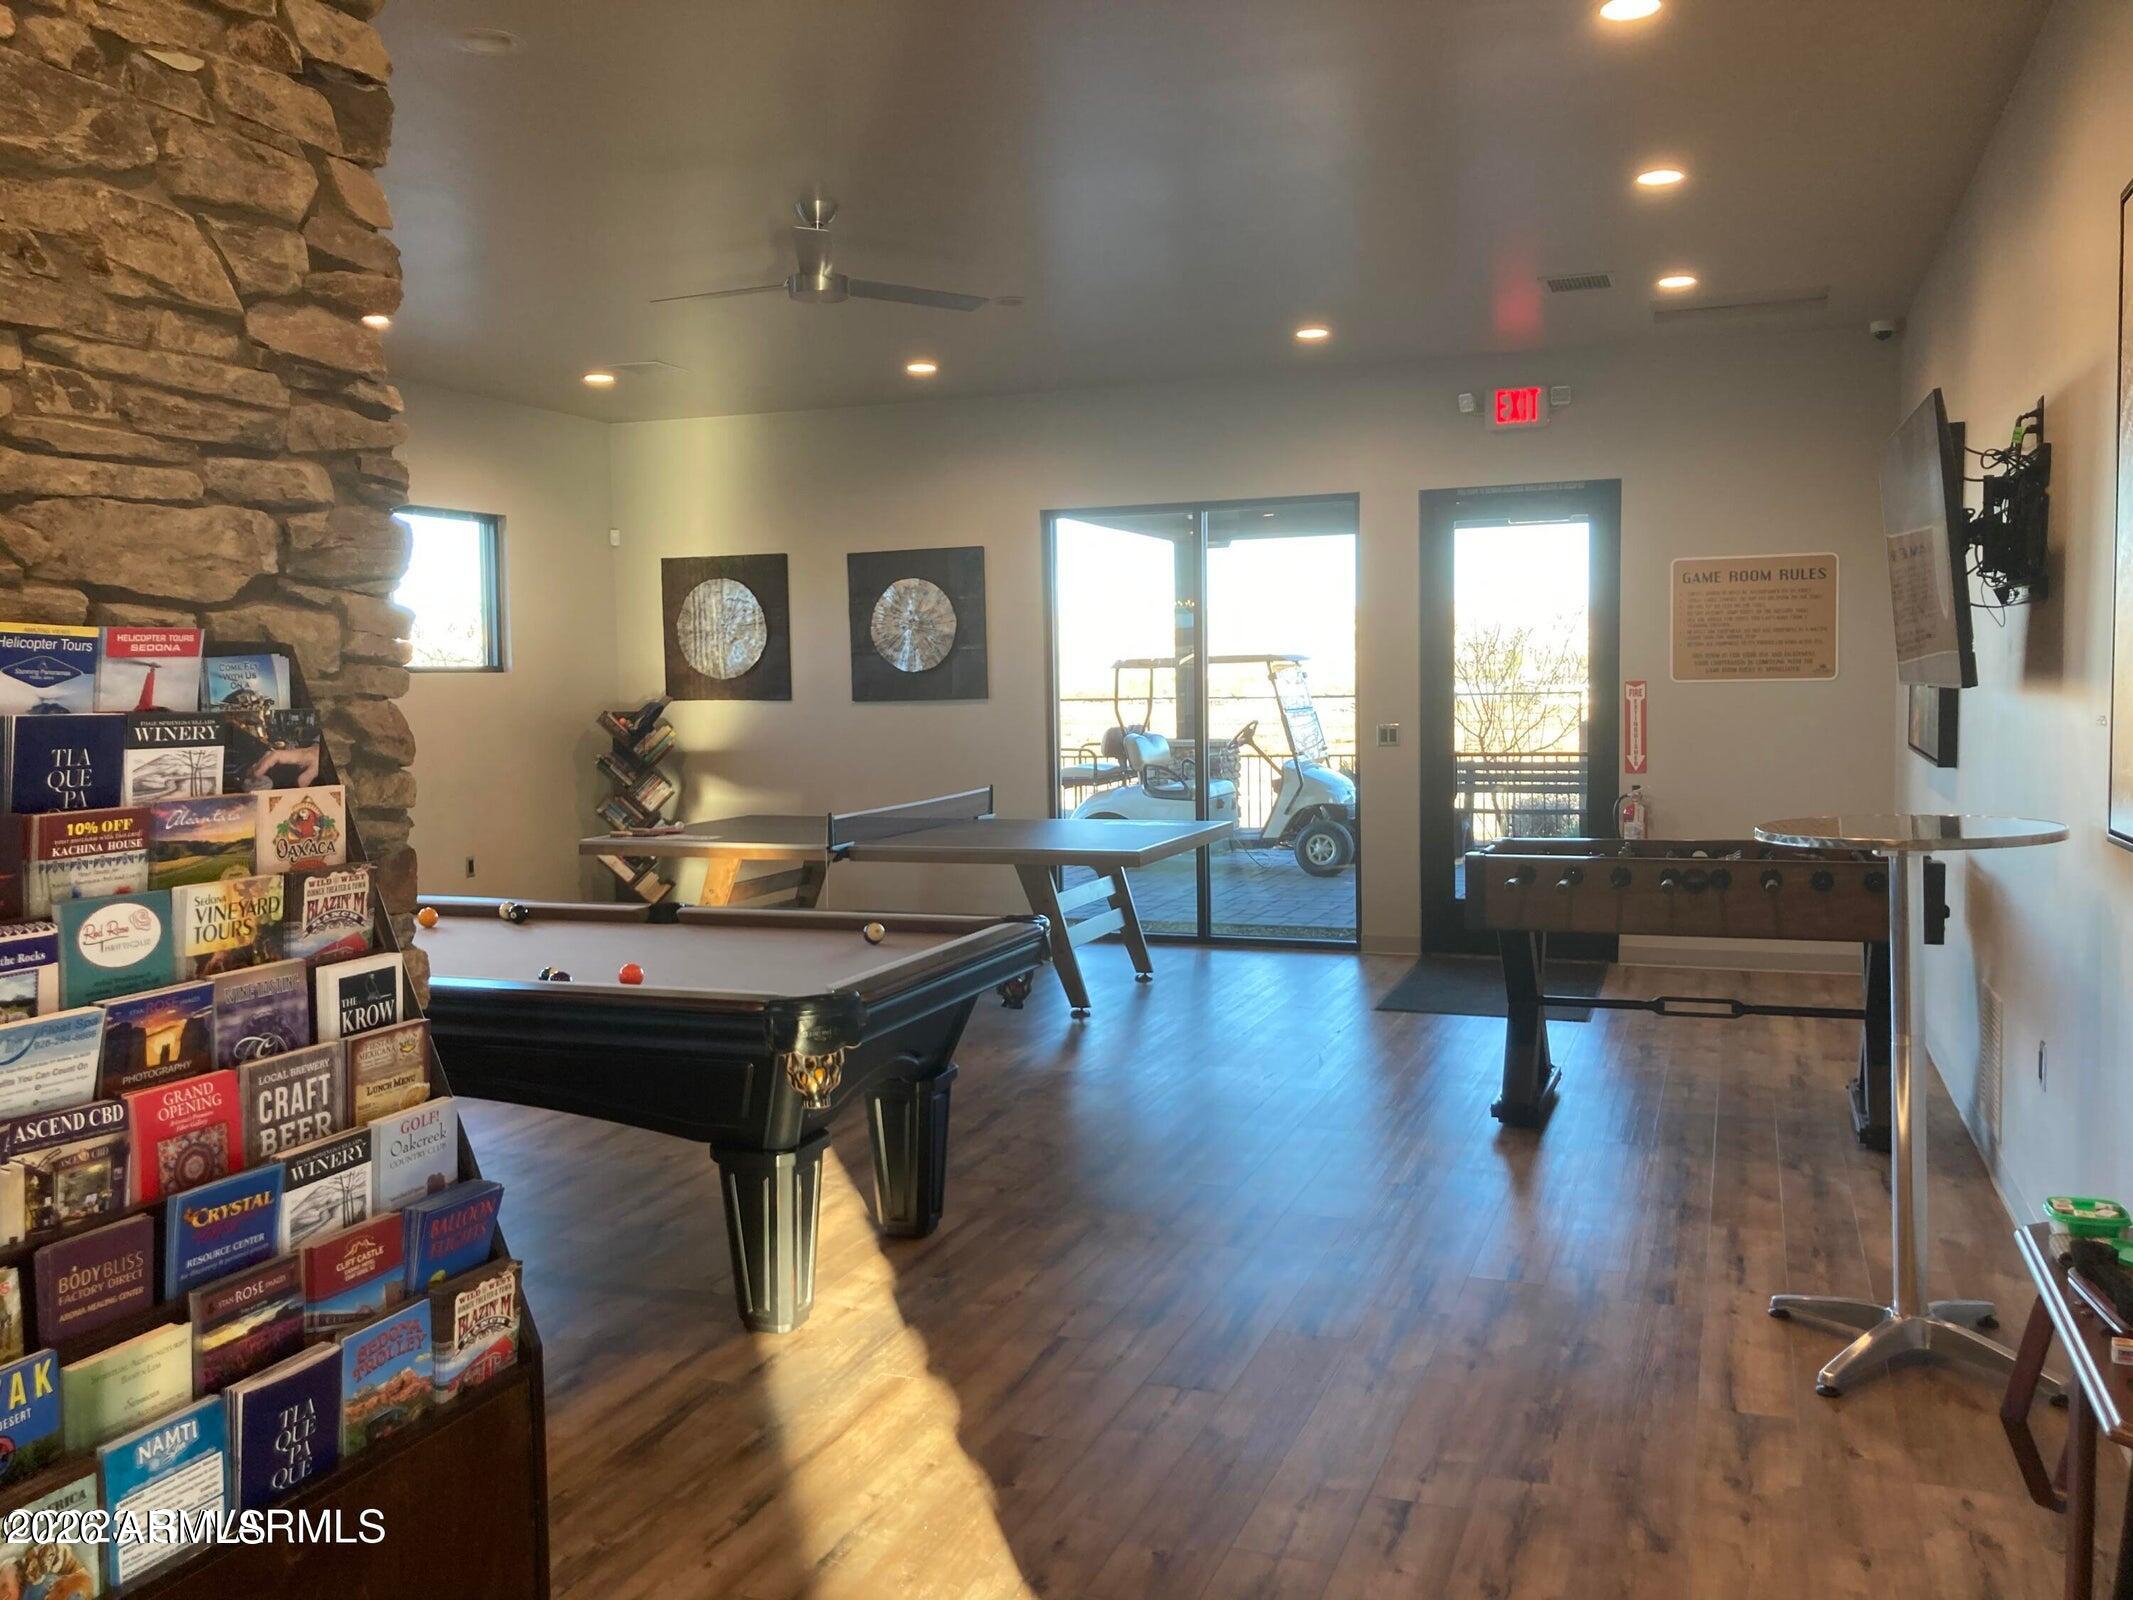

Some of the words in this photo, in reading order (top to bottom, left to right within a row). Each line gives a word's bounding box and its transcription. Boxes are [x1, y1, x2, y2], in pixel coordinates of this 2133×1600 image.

[1495, 387, 1541, 424] EXIT
[1682, 571, 1721, 584] GAME
[1729, 570, 1772, 582] ROOM
[1779, 567, 1828, 580] RULES
[0, 635, 58, 652] Helicopter
[61, 638, 93, 652] Tours
[117, 634, 166, 642] HELICOPTER
[168, 634, 194, 642] TOURS
[130, 643, 181, 652] SEDONA
[1629, 688, 1642, 697] FIRE
[134, 724, 220, 742] WINERY
[51, 748, 91, 768] TLA
[47, 768, 92, 794] QUE
[64, 790, 87, 809] PA
[67, 821, 98, 836] 10%
[101, 818, 133, 833] OFF
[52, 842, 103, 857] KACHINA
[107, 838, 143, 851] HOUSE
[275, 838, 336, 862] OAXACA
[308, 878, 332, 888] WILD
[340, 873, 365, 883] WEST
[194, 892, 226, 906] Sedona
[195, 895, 281, 923] VINEYARD
[353, 891, 366, 916] M
[83, 924, 103, 940] Red
[193, 918, 252, 945] TOURS
[17, 951, 46, 963] Rocks
[341, 997, 358, 1008] THE
[341, 999, 395, 1034] KROW
[122, 1060, 192, 1085] PHOTOGRAPHY
[258, 1070, 289, 1086] LOCAL
[290, 1058, 330, 1077] BREWERY
[163, 1082, 214, 1105] GRAND
[259, 1073, 331, 1124] CRAFT
[366, 1083, 392, 1097] LUNCH
[393, 1075, 416, 1087] MENU
[157, 1093, 222, 1122] OPENING
[14, 1113, 85, 1143] ASCEND
[89, 1104, 124, 1126] CBD
[260, 1111, 333, 1158] BEER
[401, 1110, 440, 1135] GOLF!
[390, 1123, 447, 1157] Oakcreek
[291, 1142, 367, 1181] WINERY
[192, 1191, 275, 1228] CRYSTAL
[186, 1245, 231, 1268] RESOURCE
[233, 1233, 265, 1251] CENTER
[357, 1245, 384, 1263] CASTLE
[59, 1282, 104, 1306] FACTORY
[108, 1268, 143, 1288] DIRECT
[235, 1280, 264, 1303] ROSE
[459, 1289, 480, 1304] WILD
[0, 1358, 53, 1411] AK
[279, 1398, 315, 1428] TLA
[138, 1420, 197, 1465] NAMTI
[275, 1415, 317, 1452] QUE
[290, 1440, 312, 1465] PA
[272, 1456, 313, 1489] QUE
